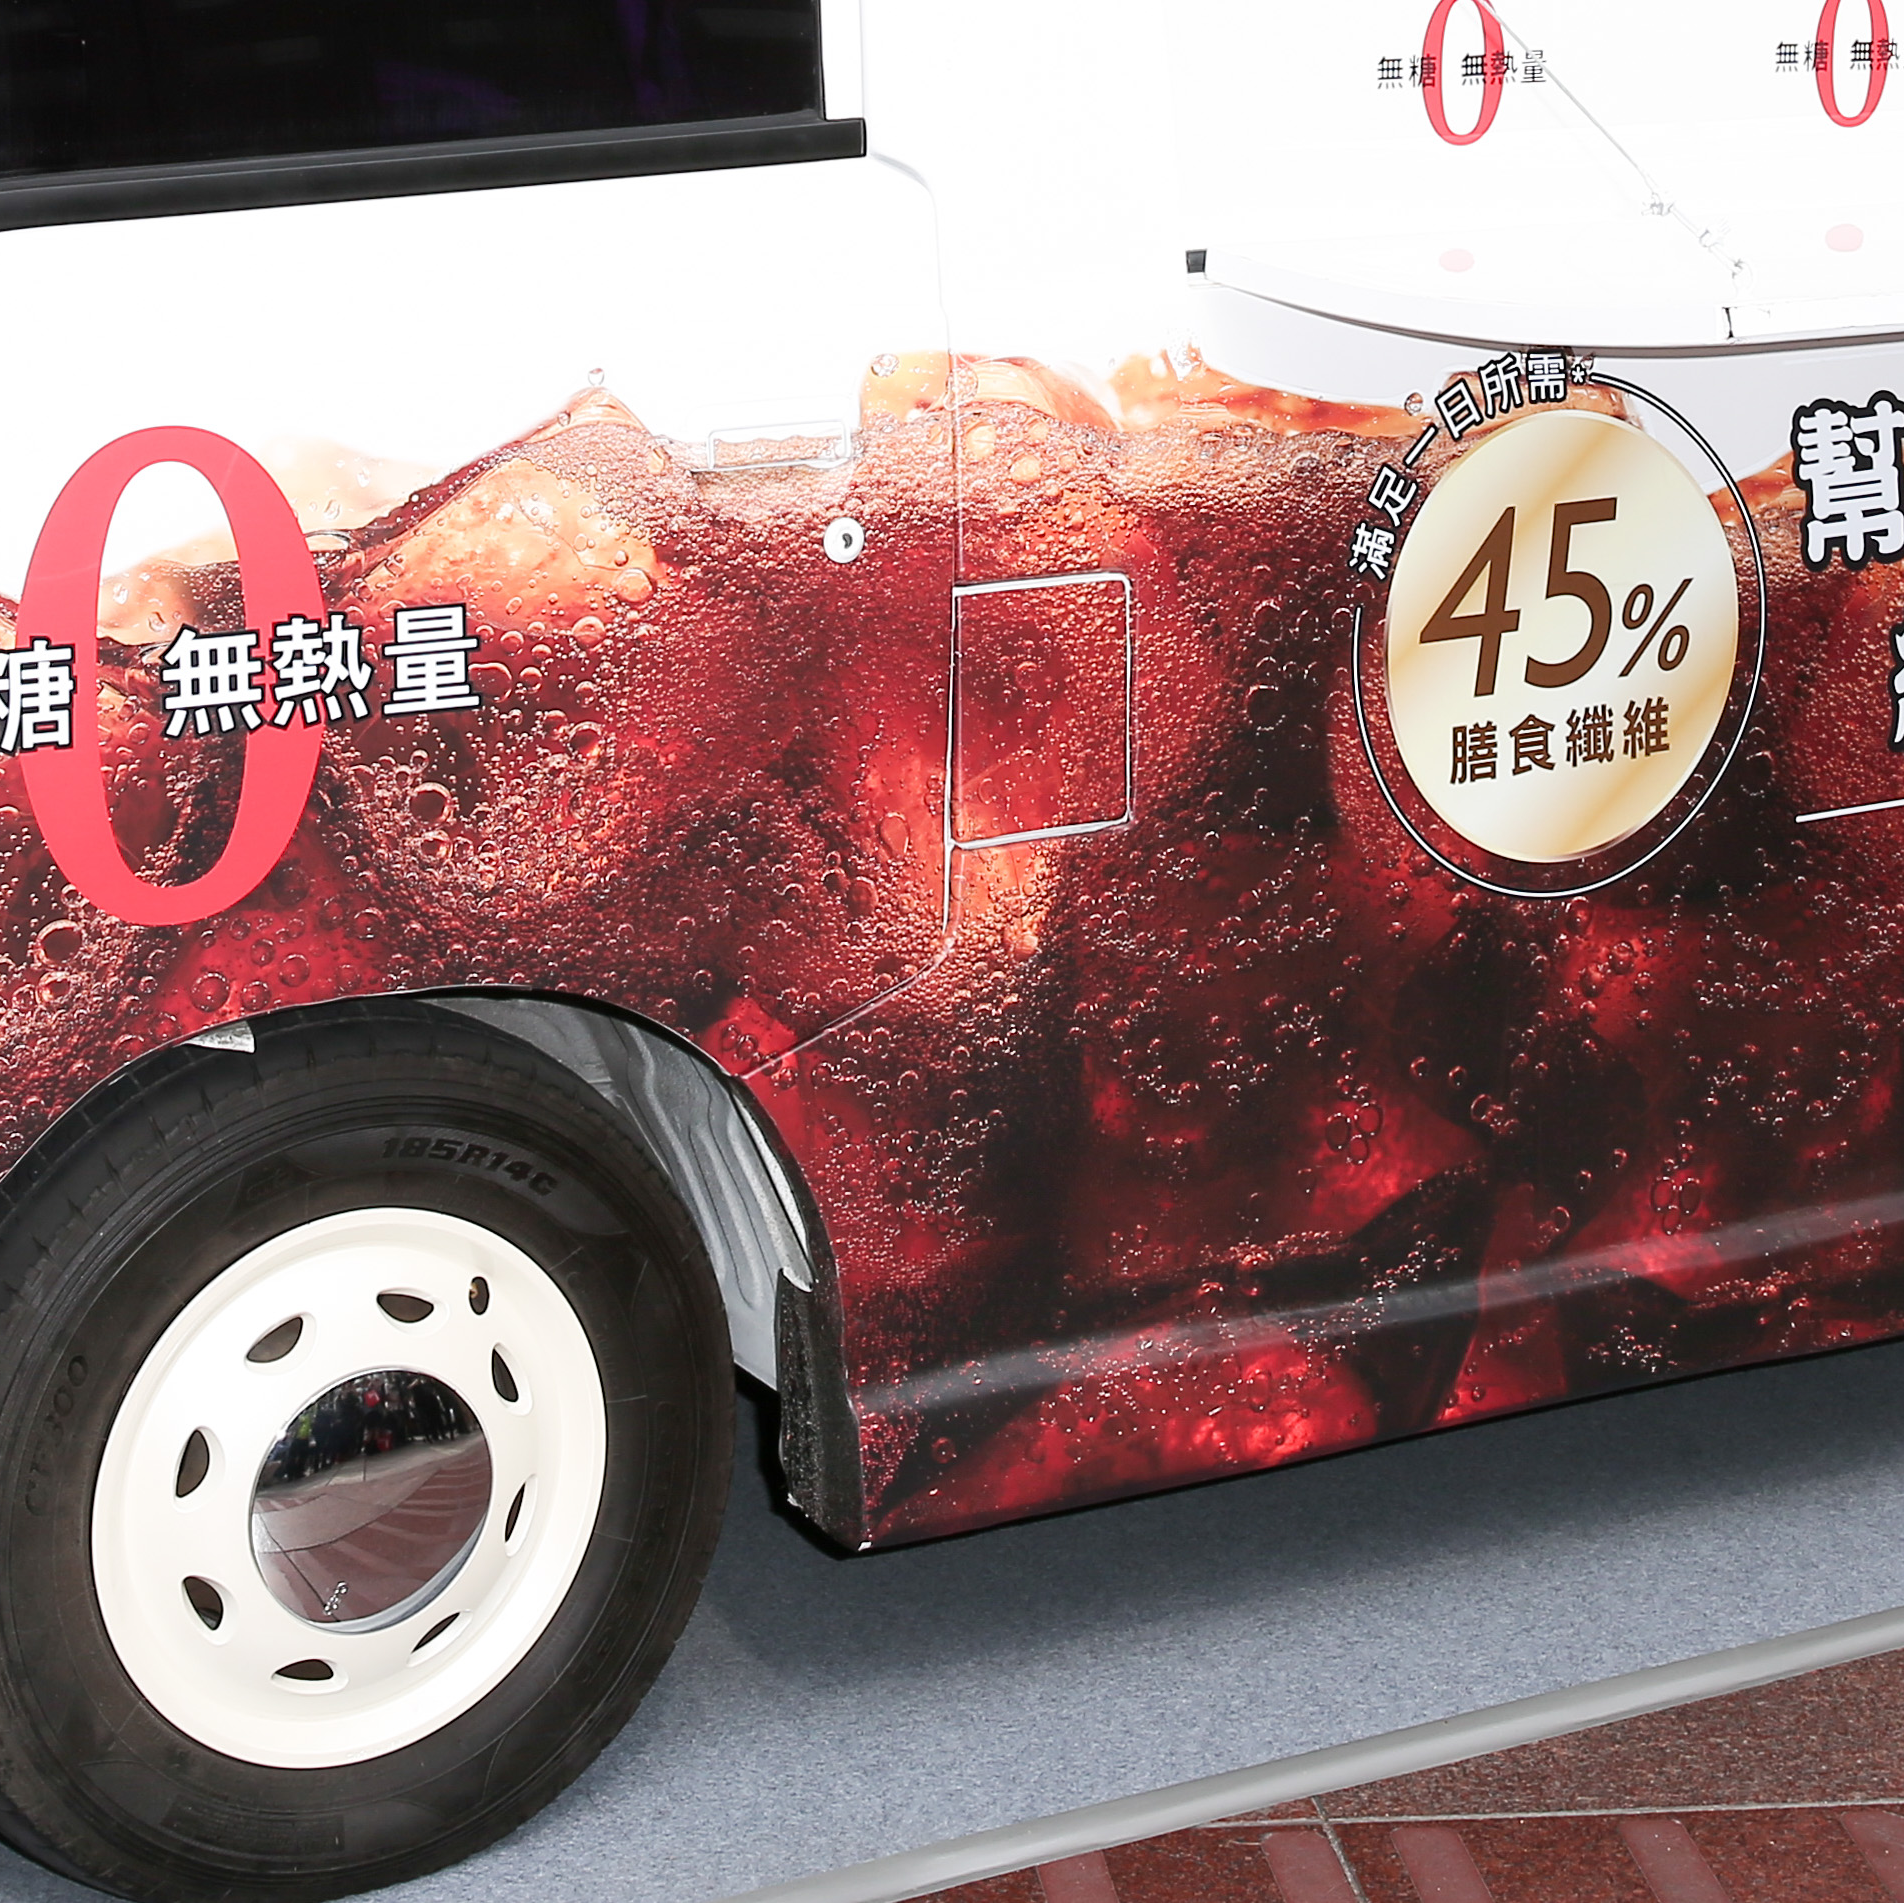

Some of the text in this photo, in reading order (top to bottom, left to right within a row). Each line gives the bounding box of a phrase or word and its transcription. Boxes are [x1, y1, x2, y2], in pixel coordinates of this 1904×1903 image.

[1377, 49, 1547, 90] 無糖 無熱量
[1774, 40, 1829, 73] 無糖
[1419, 496, 1693, 698] 45%
[15, 424, 326, 926] 0
[160, 602, 481, 741] 無熱量
[1449, 696, 1671, 786] 膳食纖維
